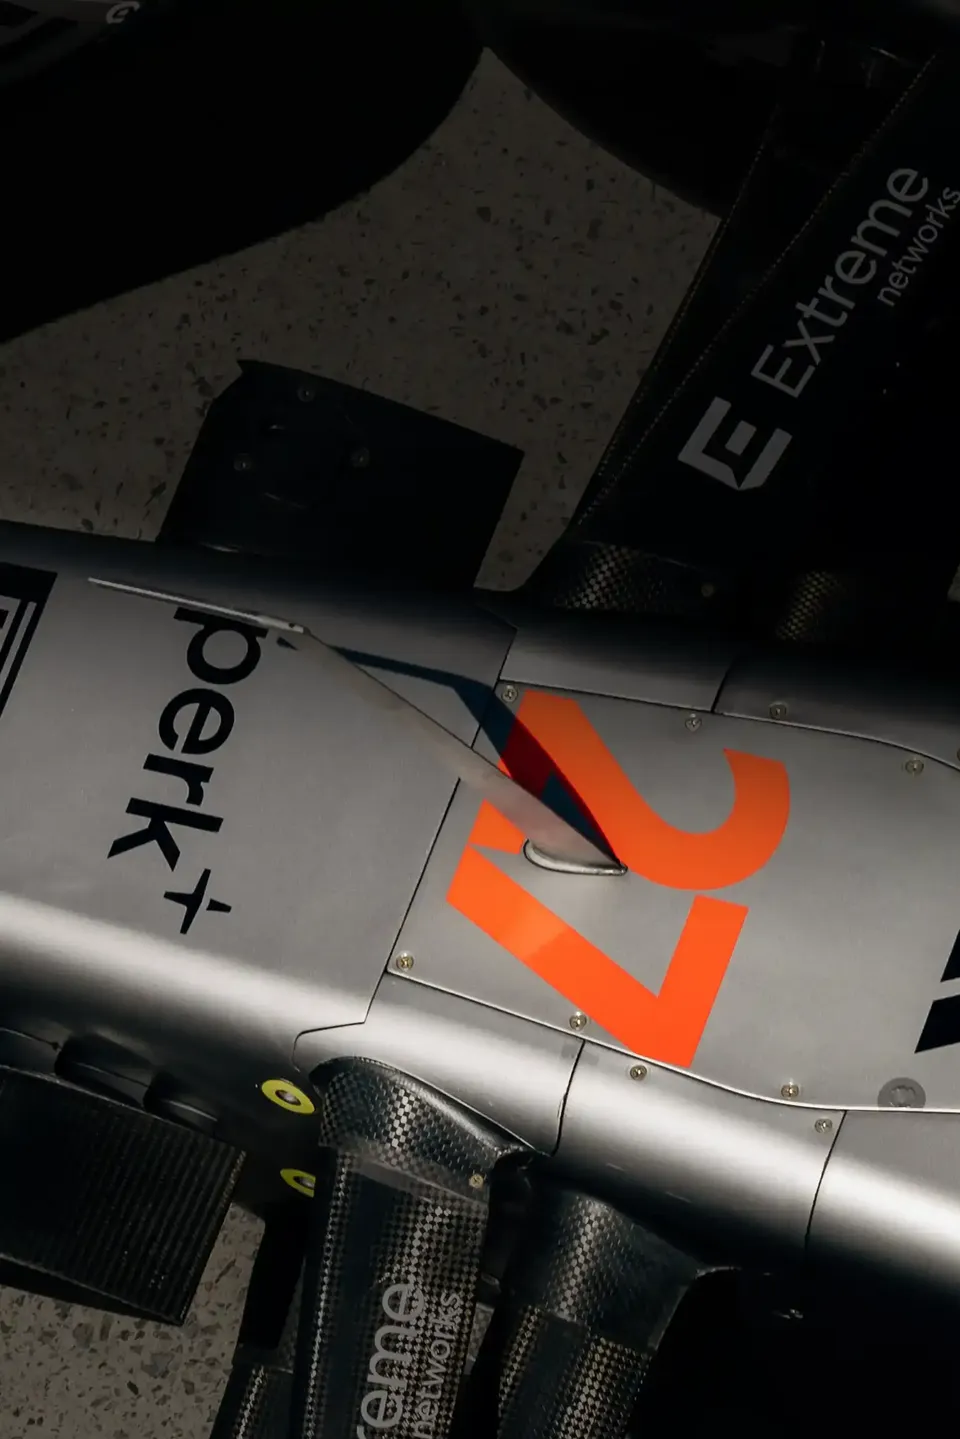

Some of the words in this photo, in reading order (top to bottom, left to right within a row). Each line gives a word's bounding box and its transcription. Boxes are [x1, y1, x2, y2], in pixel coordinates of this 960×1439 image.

[750, 167, 930, 400] Extreme
[446, 689, 791, 1068] 27
[412, 1290, 461, 1439] networks
